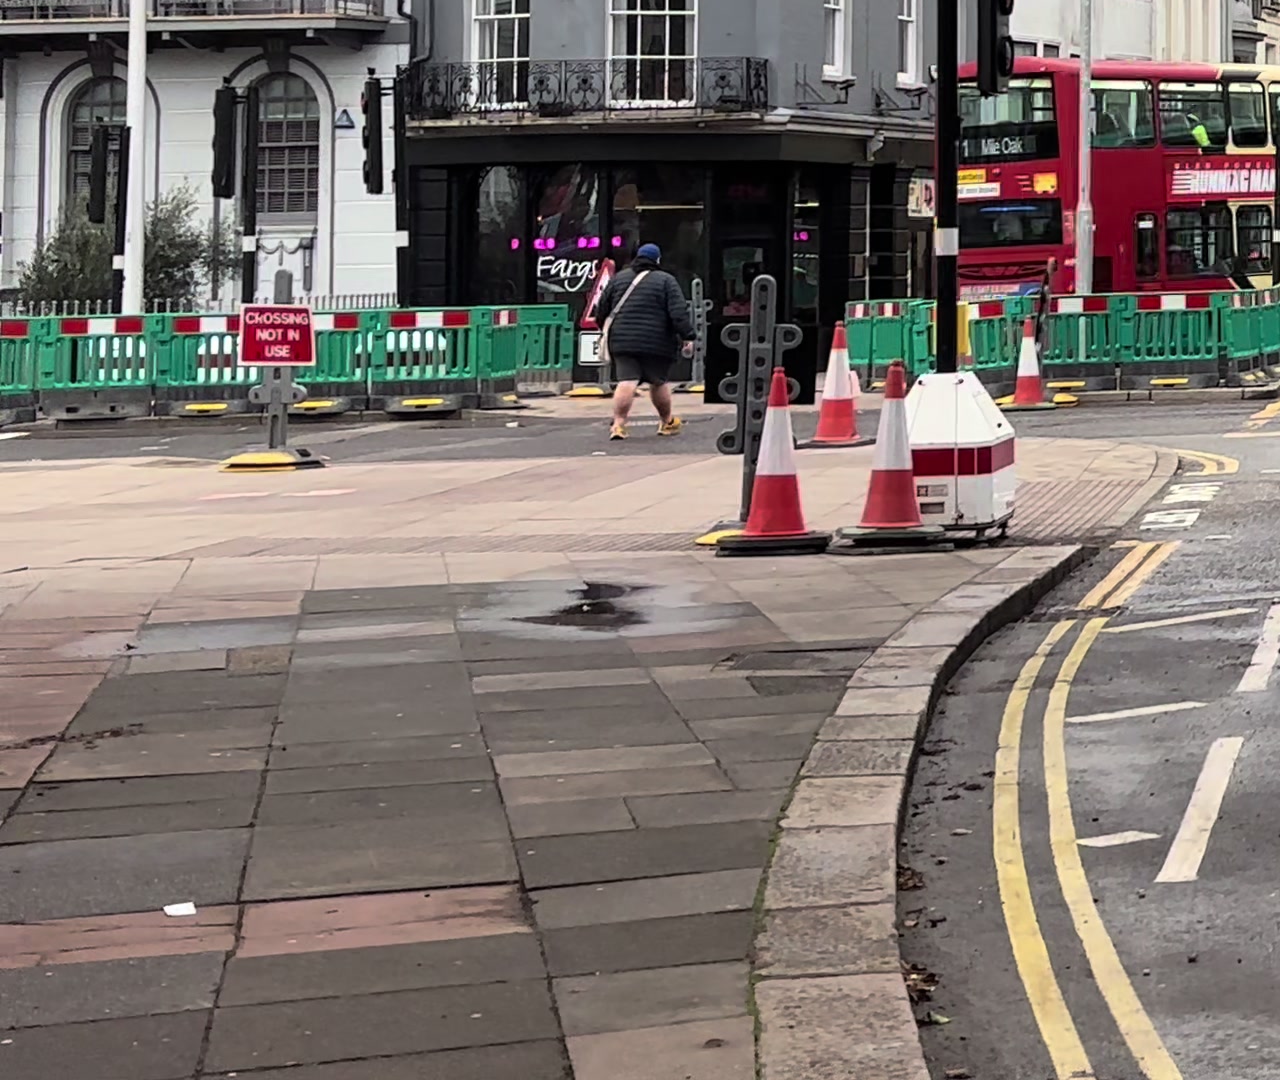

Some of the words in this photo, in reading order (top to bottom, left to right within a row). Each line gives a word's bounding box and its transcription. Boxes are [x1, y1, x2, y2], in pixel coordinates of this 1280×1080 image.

[1002, 136, 1023, 154] Oak
[537, 255, 598, 292] Fargs
[245, 311, 309, 325] CROSSING
[255, 328, 284, 341] NOT
[287, 328, 300, 341] IN
[264, 344, 291, 358] USE
